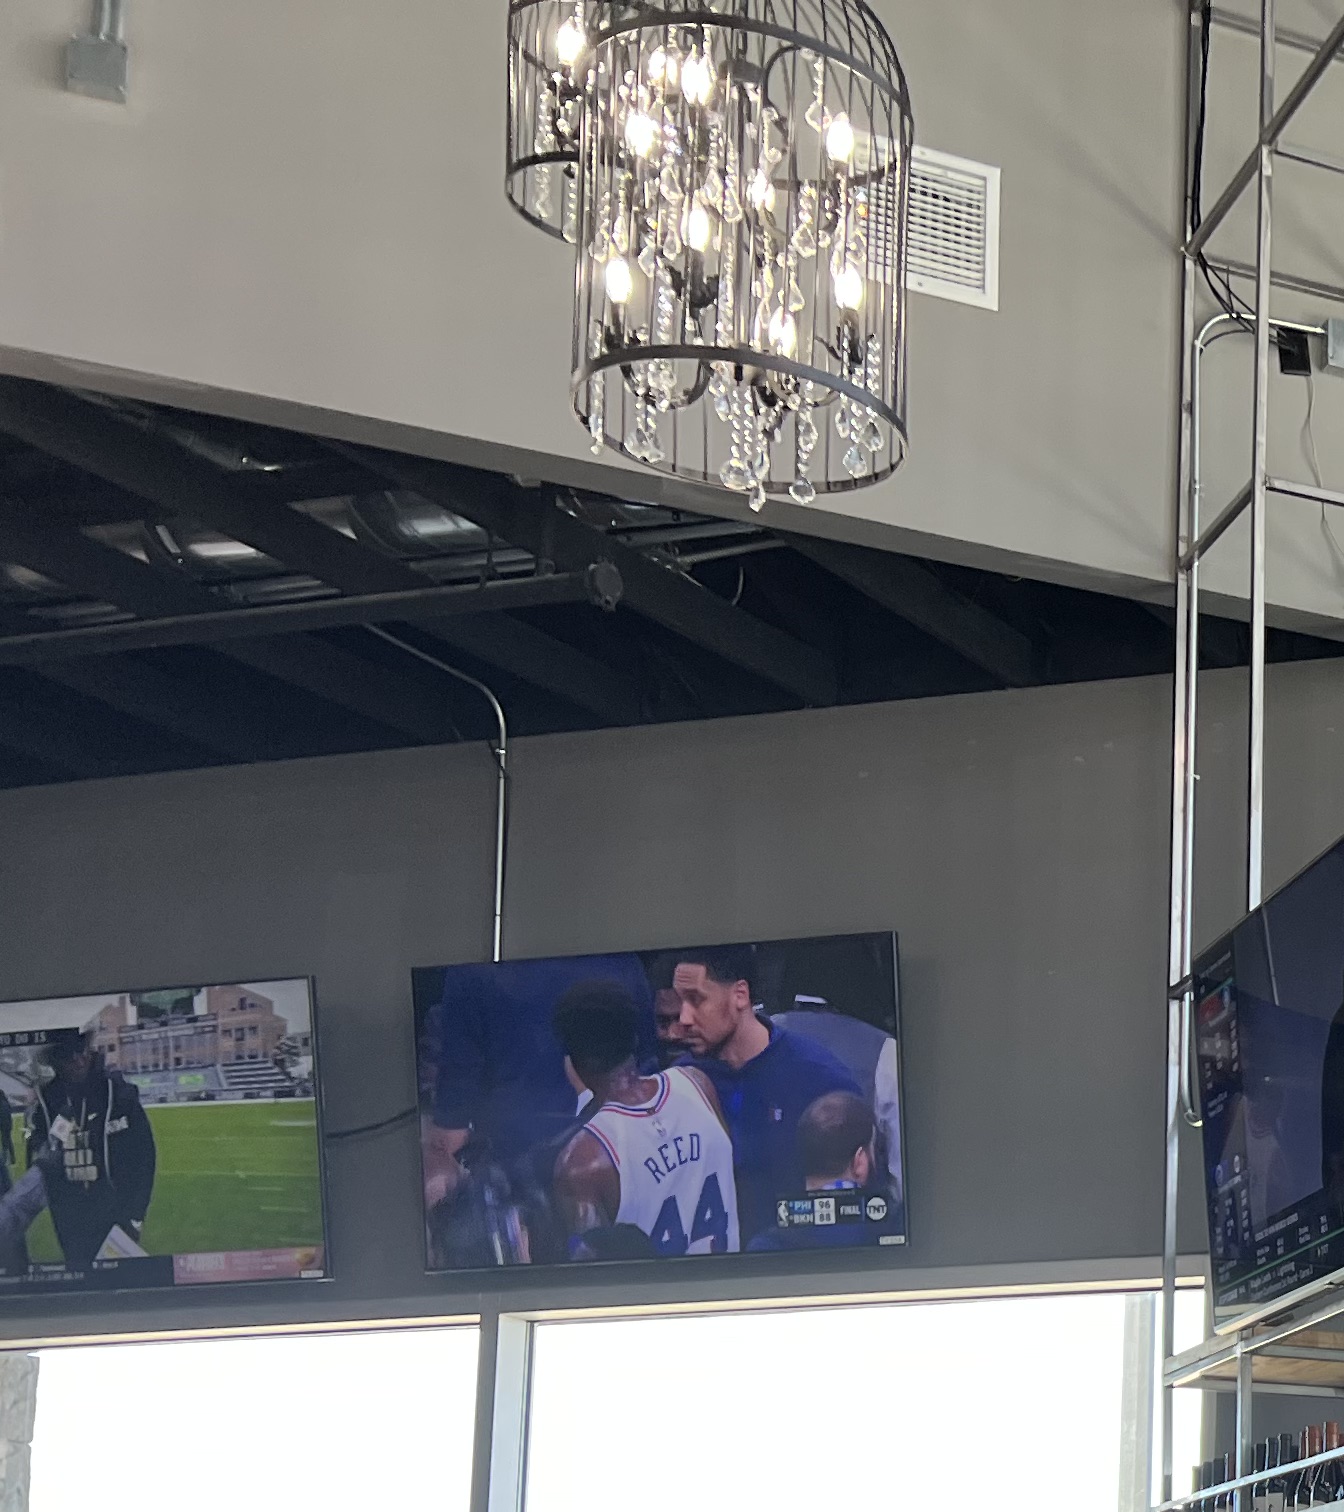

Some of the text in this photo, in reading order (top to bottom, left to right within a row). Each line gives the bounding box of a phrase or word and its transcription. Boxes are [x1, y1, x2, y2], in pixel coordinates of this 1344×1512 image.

[644, 1133, 700, 1184] REED
[650, 1172, 728, 1251] 44
[794, 1201, 812, 1211] PHI
[868, 1204, 886, 1214] TNT
